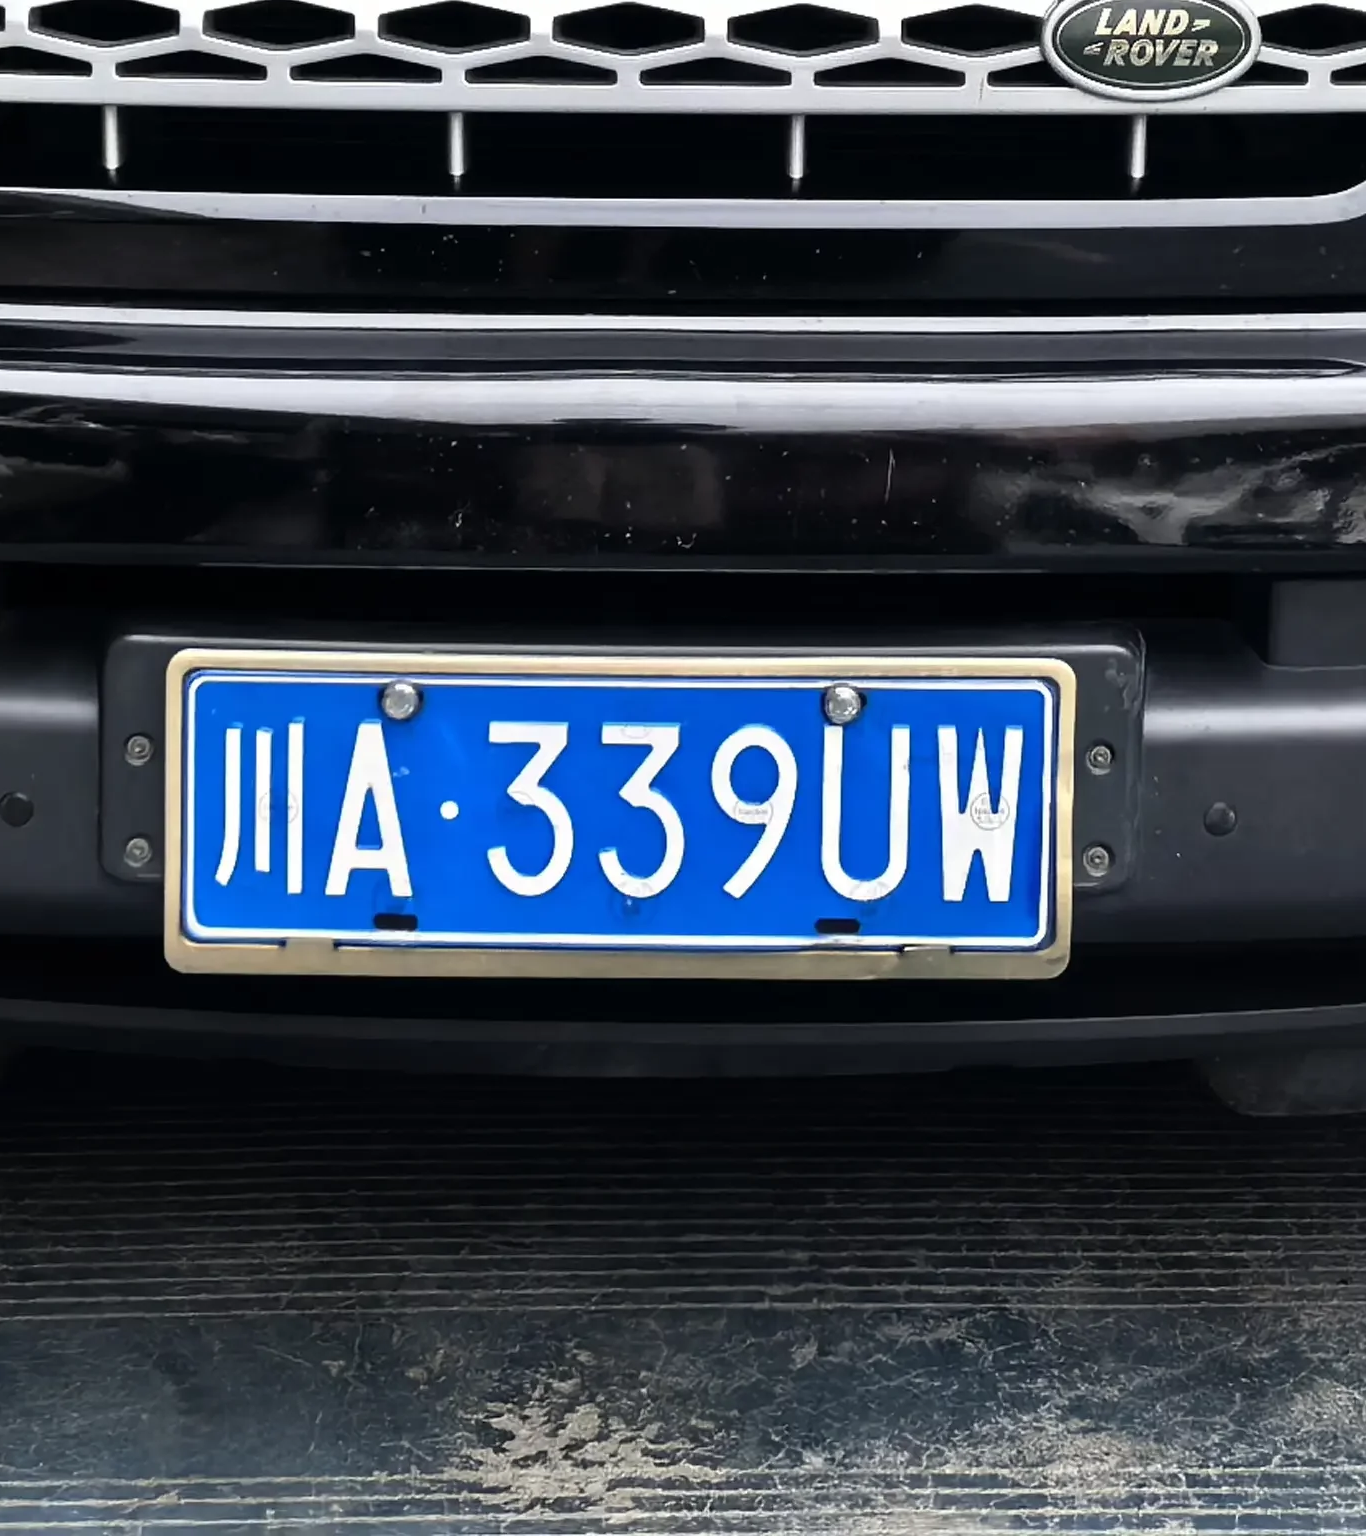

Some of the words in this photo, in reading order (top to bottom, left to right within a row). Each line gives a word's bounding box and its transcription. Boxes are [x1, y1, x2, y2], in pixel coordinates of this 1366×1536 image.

[1094, 7, 1190, 36] LAND
[1102, 38, 1220, 67] ROVER
[214, 717, 1024, 902] 川A·339UW
